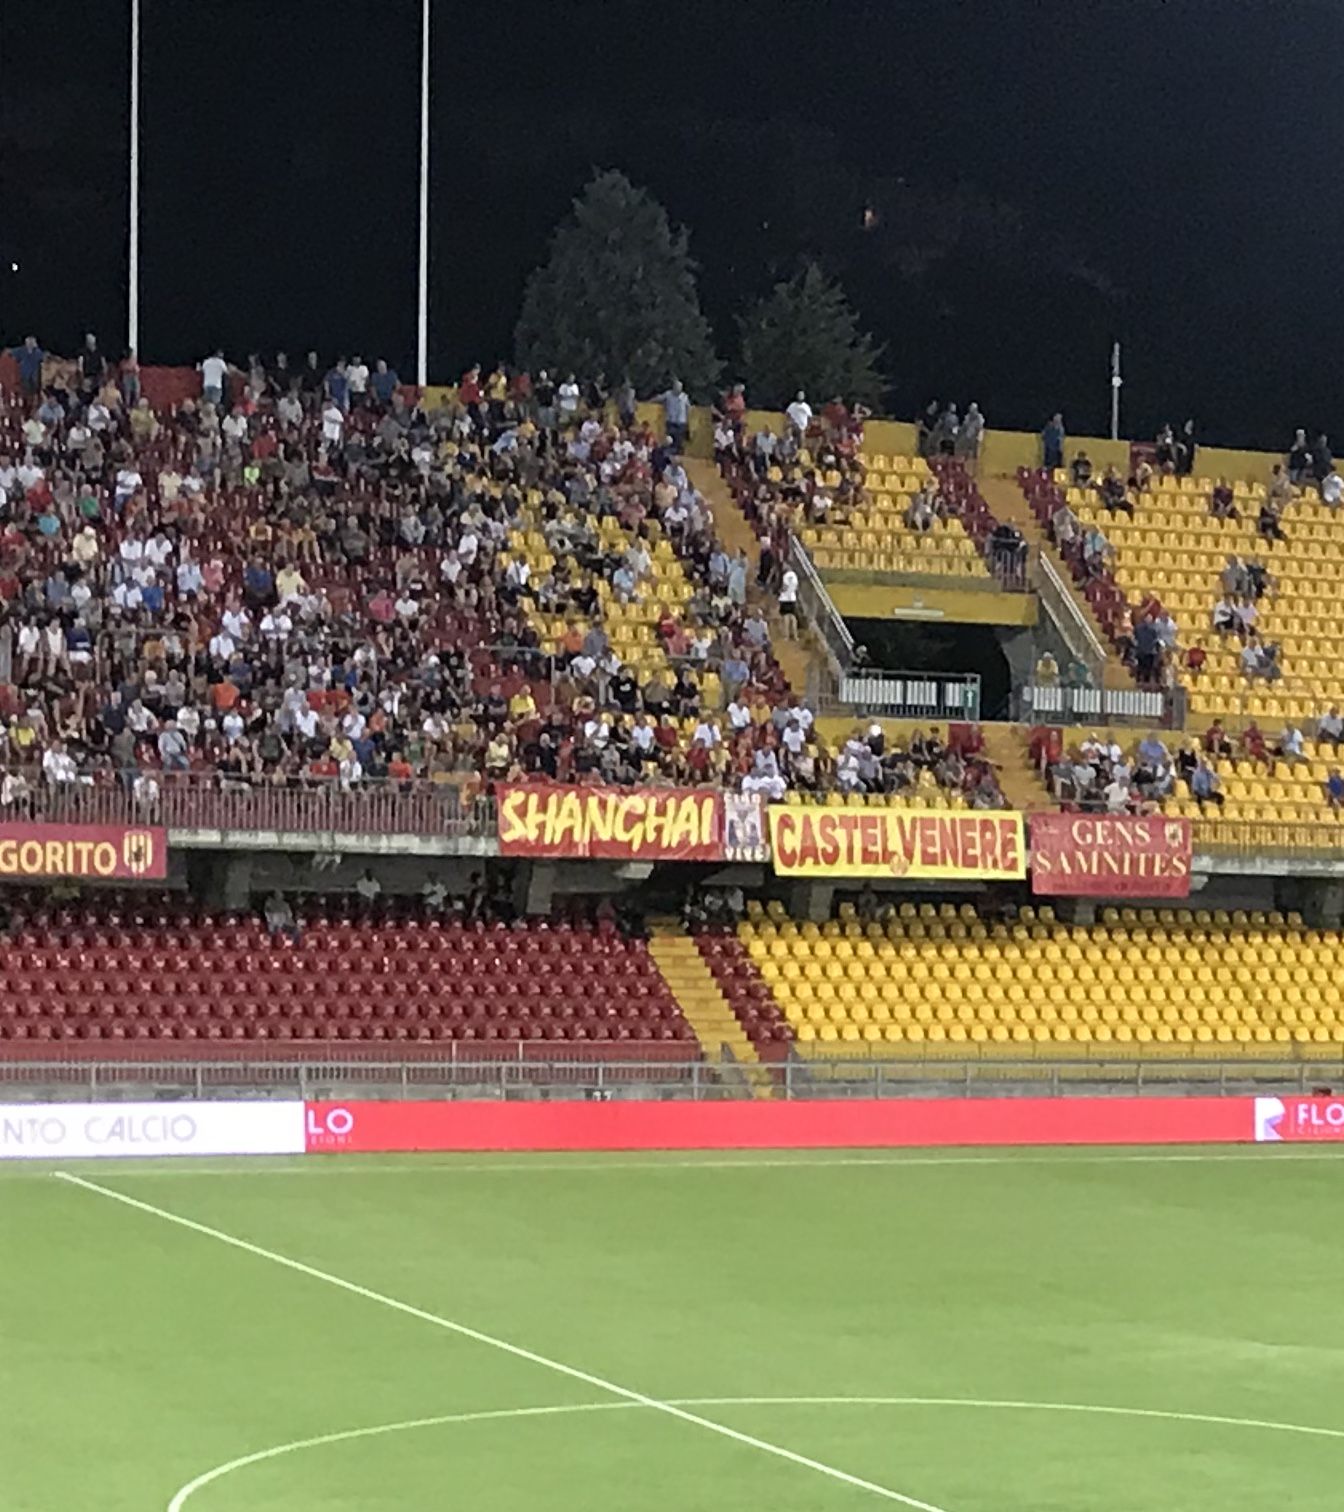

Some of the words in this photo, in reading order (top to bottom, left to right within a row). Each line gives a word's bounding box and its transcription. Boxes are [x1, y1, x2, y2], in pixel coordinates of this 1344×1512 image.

[501, 789, 715, 852] SHANGHAI
[1071, 819, 1152, 847] GENS
[0, 839, 118, 876] GORITO
[776, 812, 1019, 873] CASTELVENERE
[1032, 849, 1188, 878] SAMNITES
[84, 1113, 198, 1143] CALCIO
